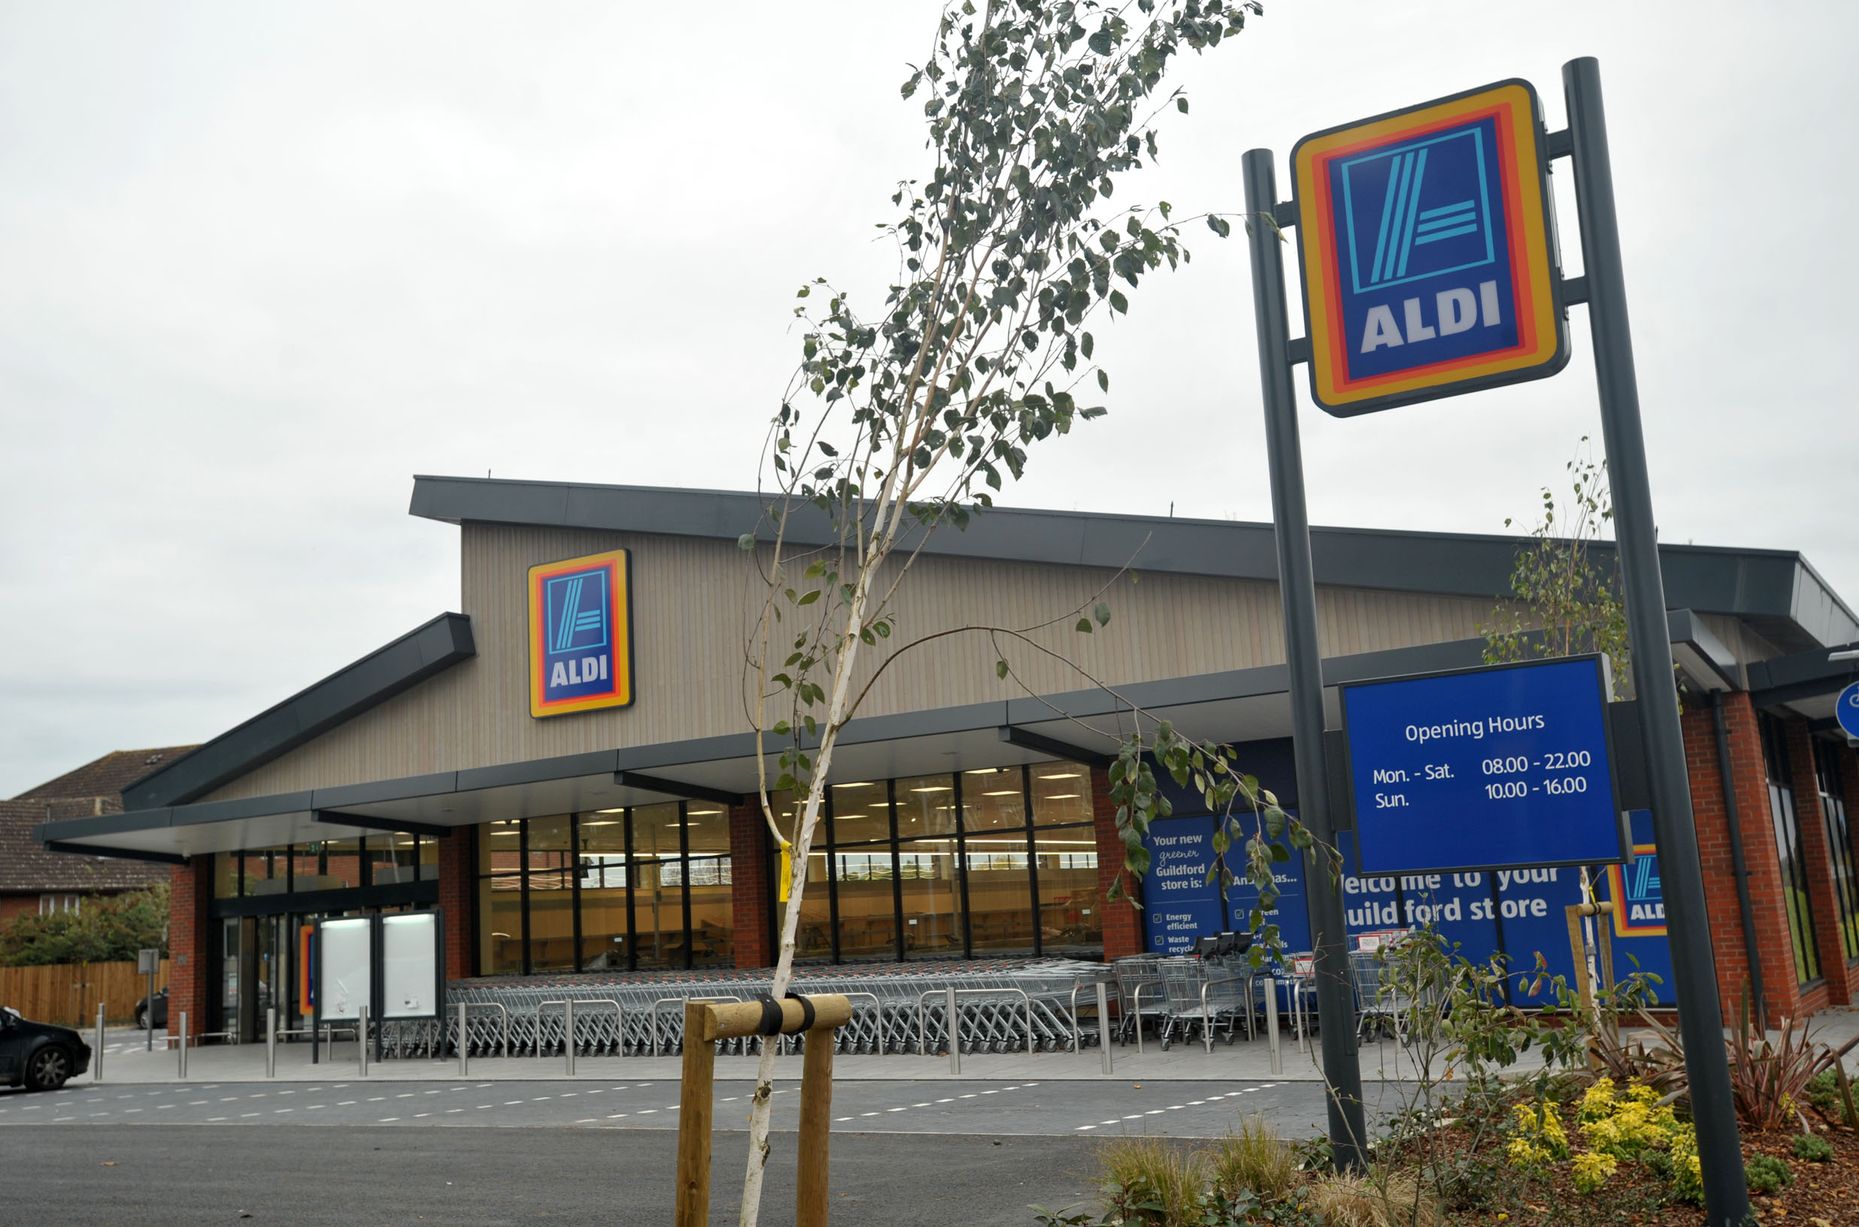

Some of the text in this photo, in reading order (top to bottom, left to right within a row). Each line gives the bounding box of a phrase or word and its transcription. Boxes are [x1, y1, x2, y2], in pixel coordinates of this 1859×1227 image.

[1360, 280, 1501, 354] ALDI
[550, 655, 608, 688] ALDI
[1405, 714, 1545, 744] Opening Hours
[1373, 768, 1410, 785] Mon.
[1424, 763, 1455, 780] Sat.
[1482, 756, 1529, 776] 08.00
[1544, 750, 1591, 770] 22.00
[1375, 792, 1410, 809] Sun.
[1485, 781, 1528, 800] 10.00
[1543, 776, 1588, 795] 16.00
[1153, 834, 1203, 847] Your new
[1159, 850, 1200, 867] greener
[1156, 864, 1206, 878] Guildford
[1342, 867, 1559, 895] elcome to your
[1161, 877, 1203, 891] store is:
[1166, 913, 1192, 923] Energy
[1344, 897, 1548, 927] uildford store
[1166, 922, 1198, 931] efficient
[1168, 936, 1190, 944] Waste
